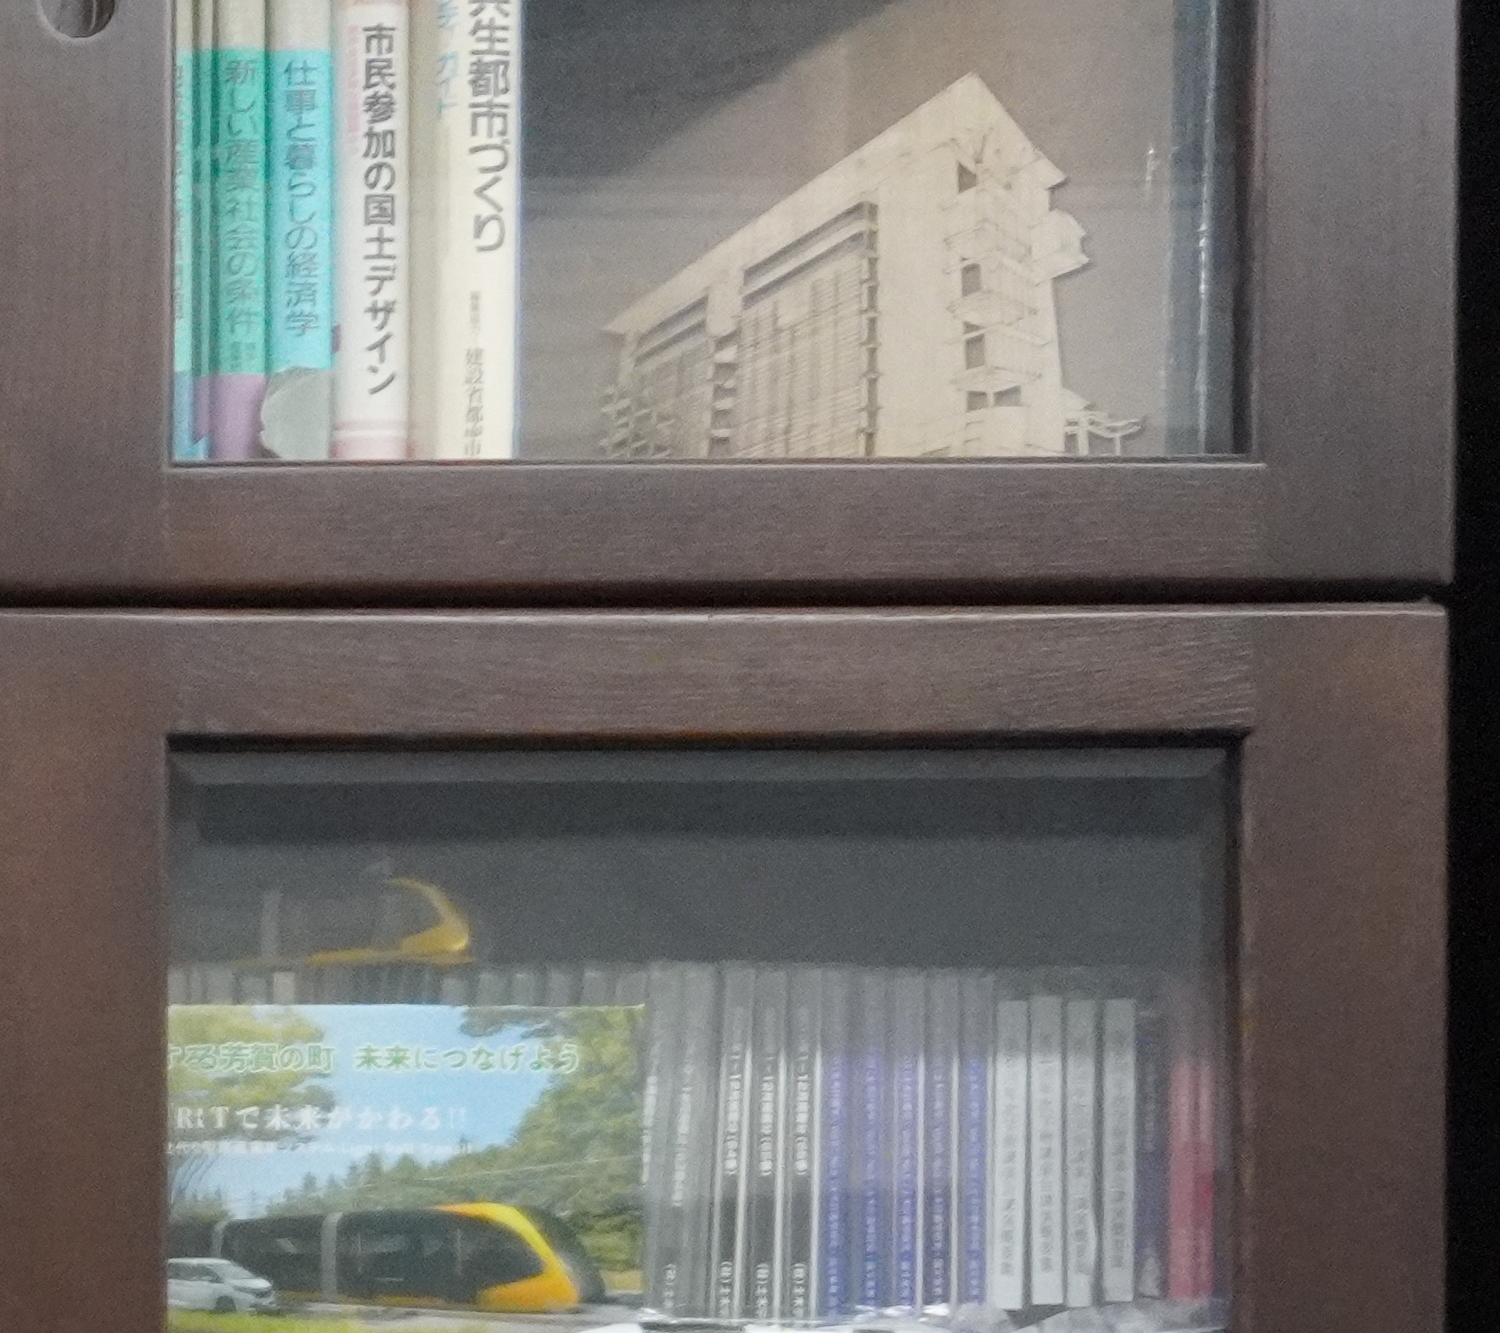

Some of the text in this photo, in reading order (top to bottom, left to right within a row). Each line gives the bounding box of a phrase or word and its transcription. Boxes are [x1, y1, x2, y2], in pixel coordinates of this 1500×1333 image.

[361, 22, 399, 395] 市民参加の国土デザイン
